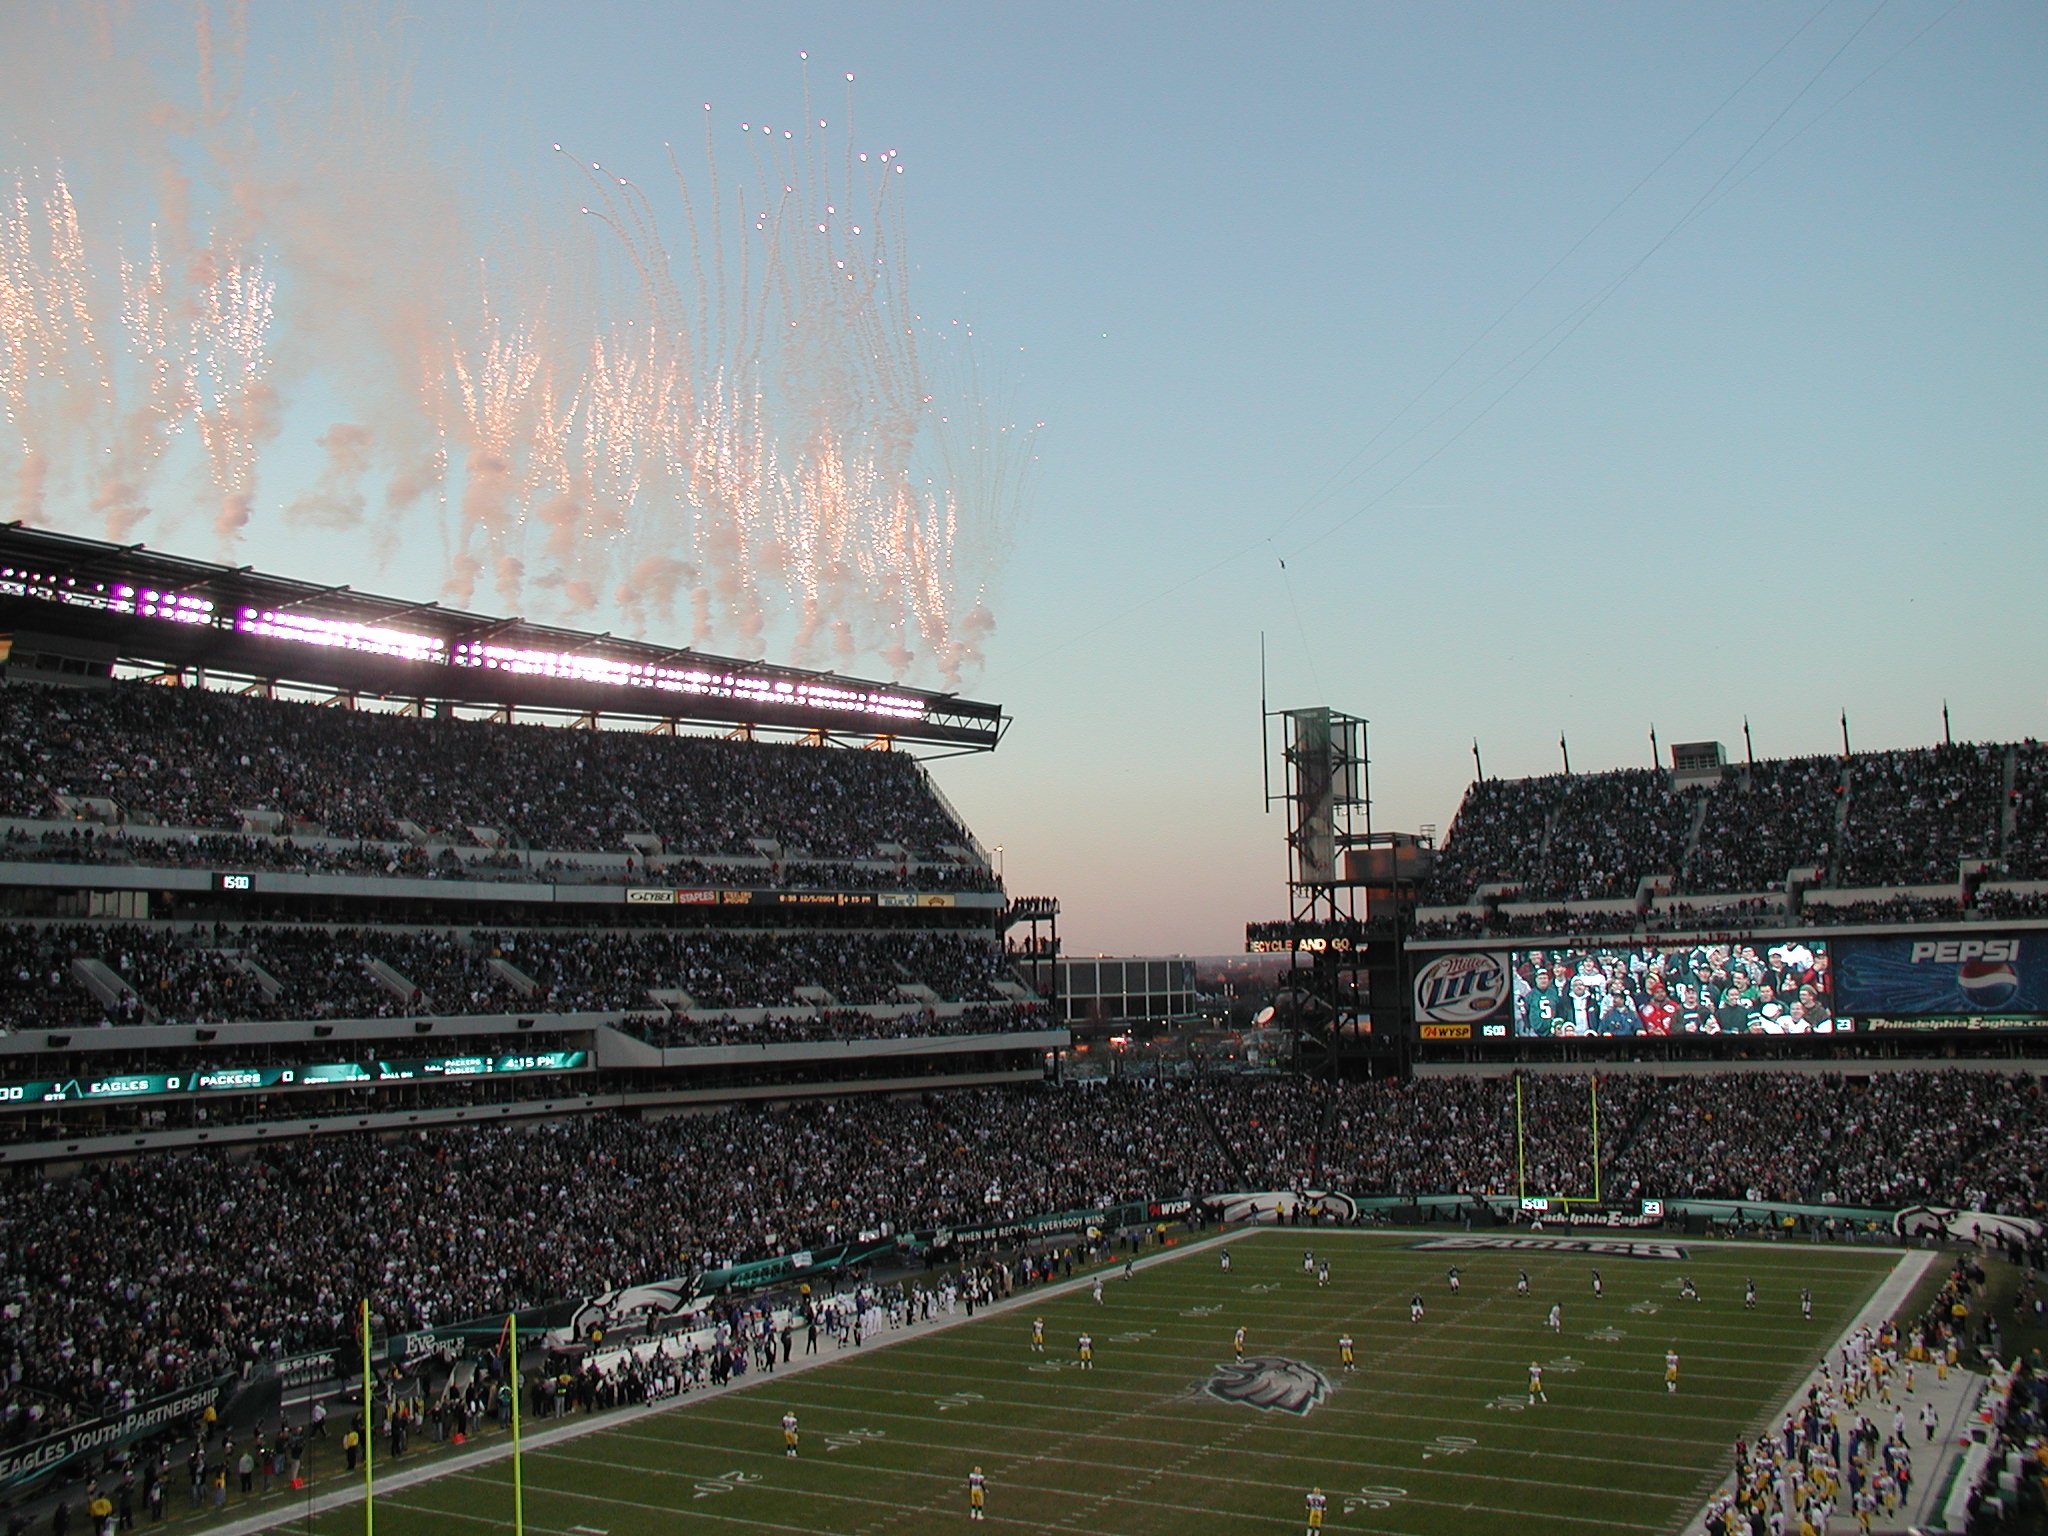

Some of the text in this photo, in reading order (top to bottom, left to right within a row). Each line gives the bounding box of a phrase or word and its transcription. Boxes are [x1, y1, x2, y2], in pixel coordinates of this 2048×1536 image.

[680, 891, 715, 903] STAPLES
[1298, 938, 1327, 951] AND
[1910, 939, 2020, 963] PEPSI
[1441, 958, 1486, 973] Miller
[1438, 1026, 1469, 1037] WYSP
[90, 1077, 180, 1094] EAGLES 0
[200, 1070, 294, 1087] PACKERS 0
[1161, 1201, 1191, 1214] WYSP
[957, 1230, 981, 1242] WHEN
[984, 1228, 997, 1239] WE
[1038, 1217, 1082, 1232] EVERYBODY
[70, 1421, 122, 1453] YOUTH
[124, 1387, 220, 1434] PARTNERSHIP
